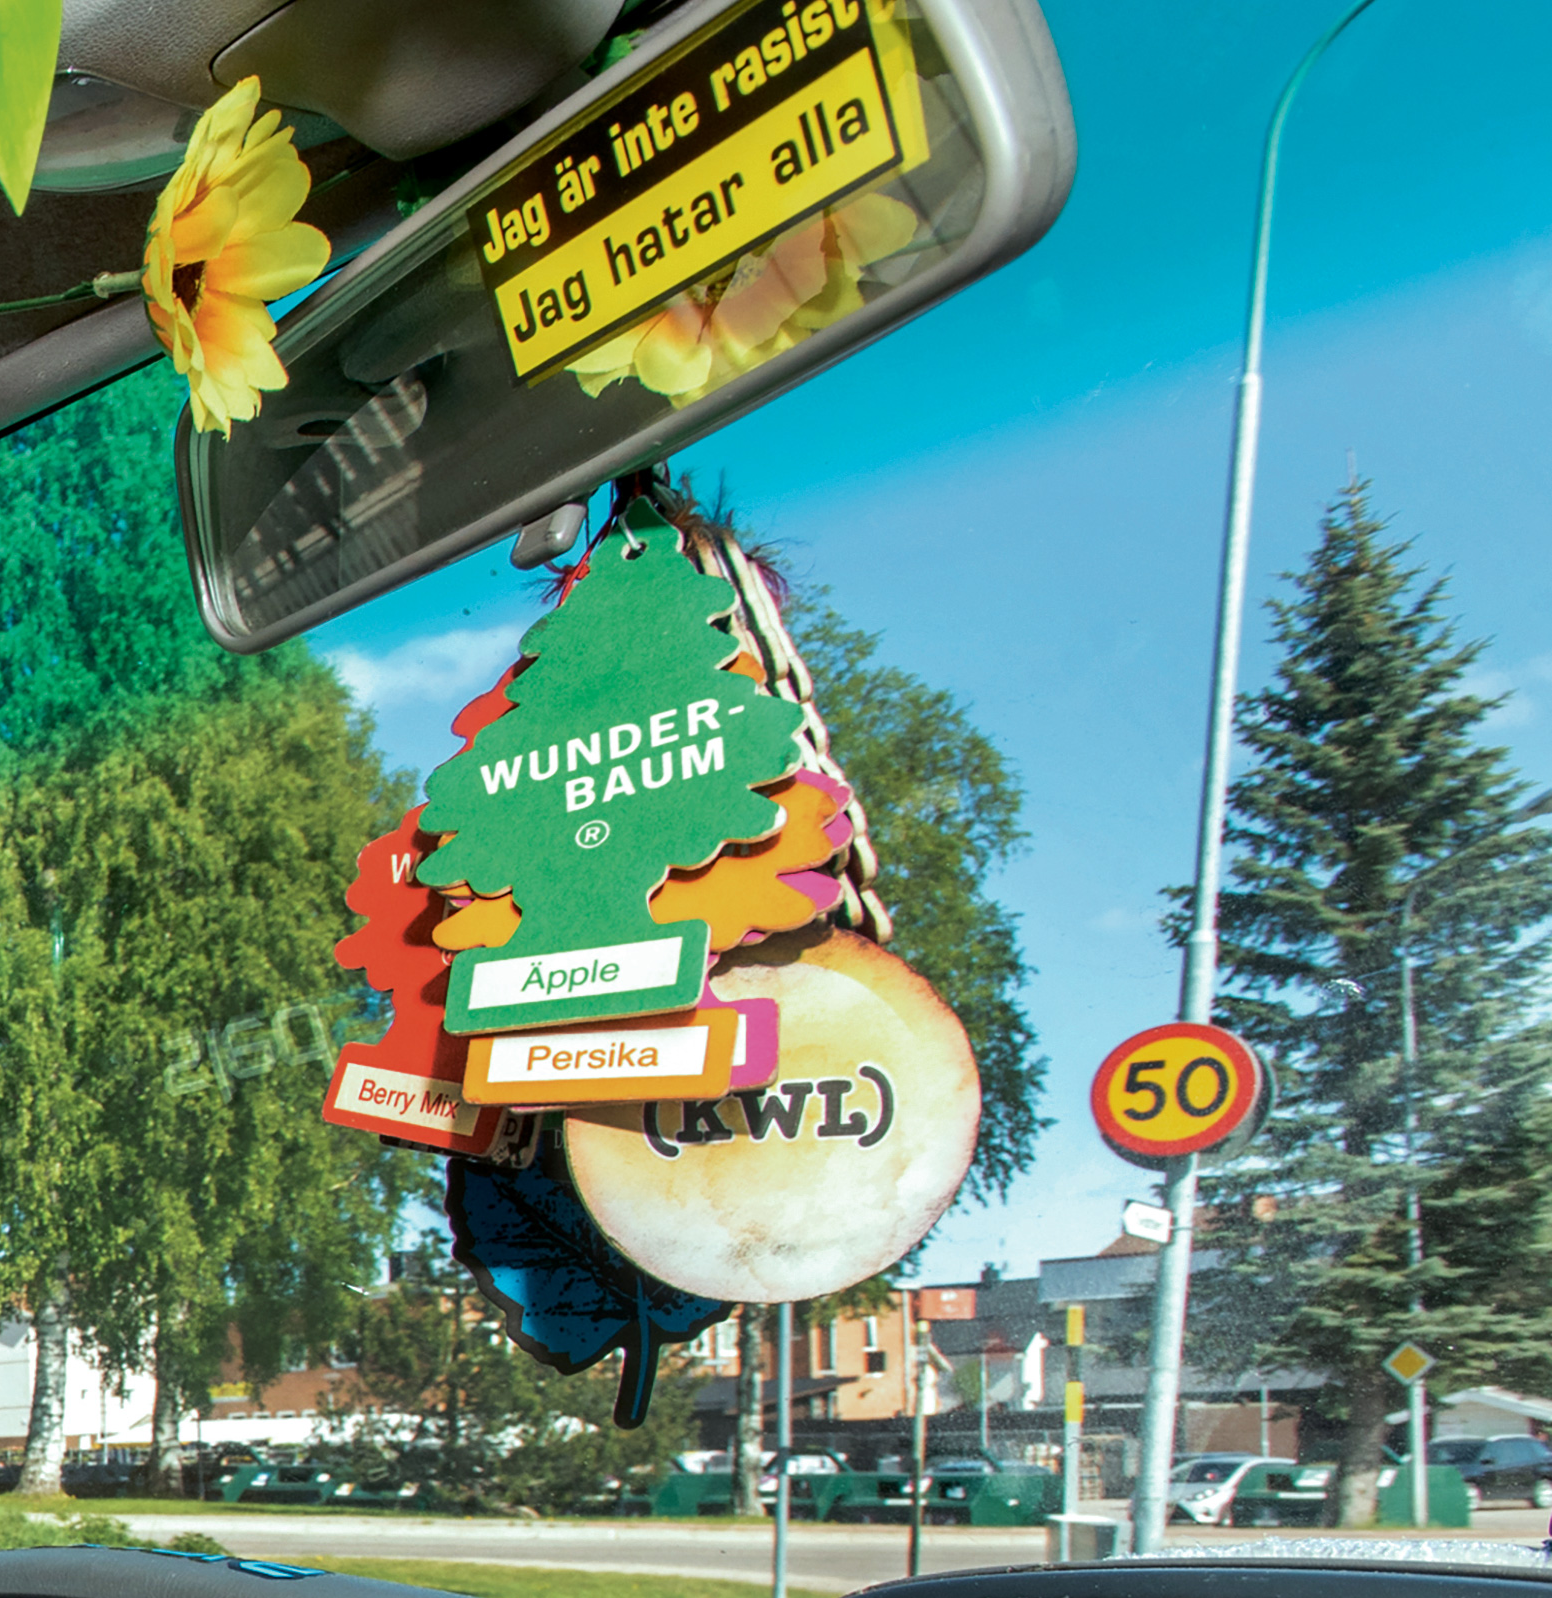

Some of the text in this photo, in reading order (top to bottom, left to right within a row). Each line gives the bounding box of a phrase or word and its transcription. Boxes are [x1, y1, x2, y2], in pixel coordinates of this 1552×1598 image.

[482, 0, 863, 265] Jag är inte rasist
[513, 92, 871, 344] Jag hatar alla
[479, 696, 747, 796] WUNDER-
[564, 736, 727, 813] BAUM
[520, 957, 622, 995] Äpple
[525, 1041, 660, 1075] Persika
[1123, 1056, 1230, 1122] 50
[357, 1078, 462, 1120] Berry Mix
